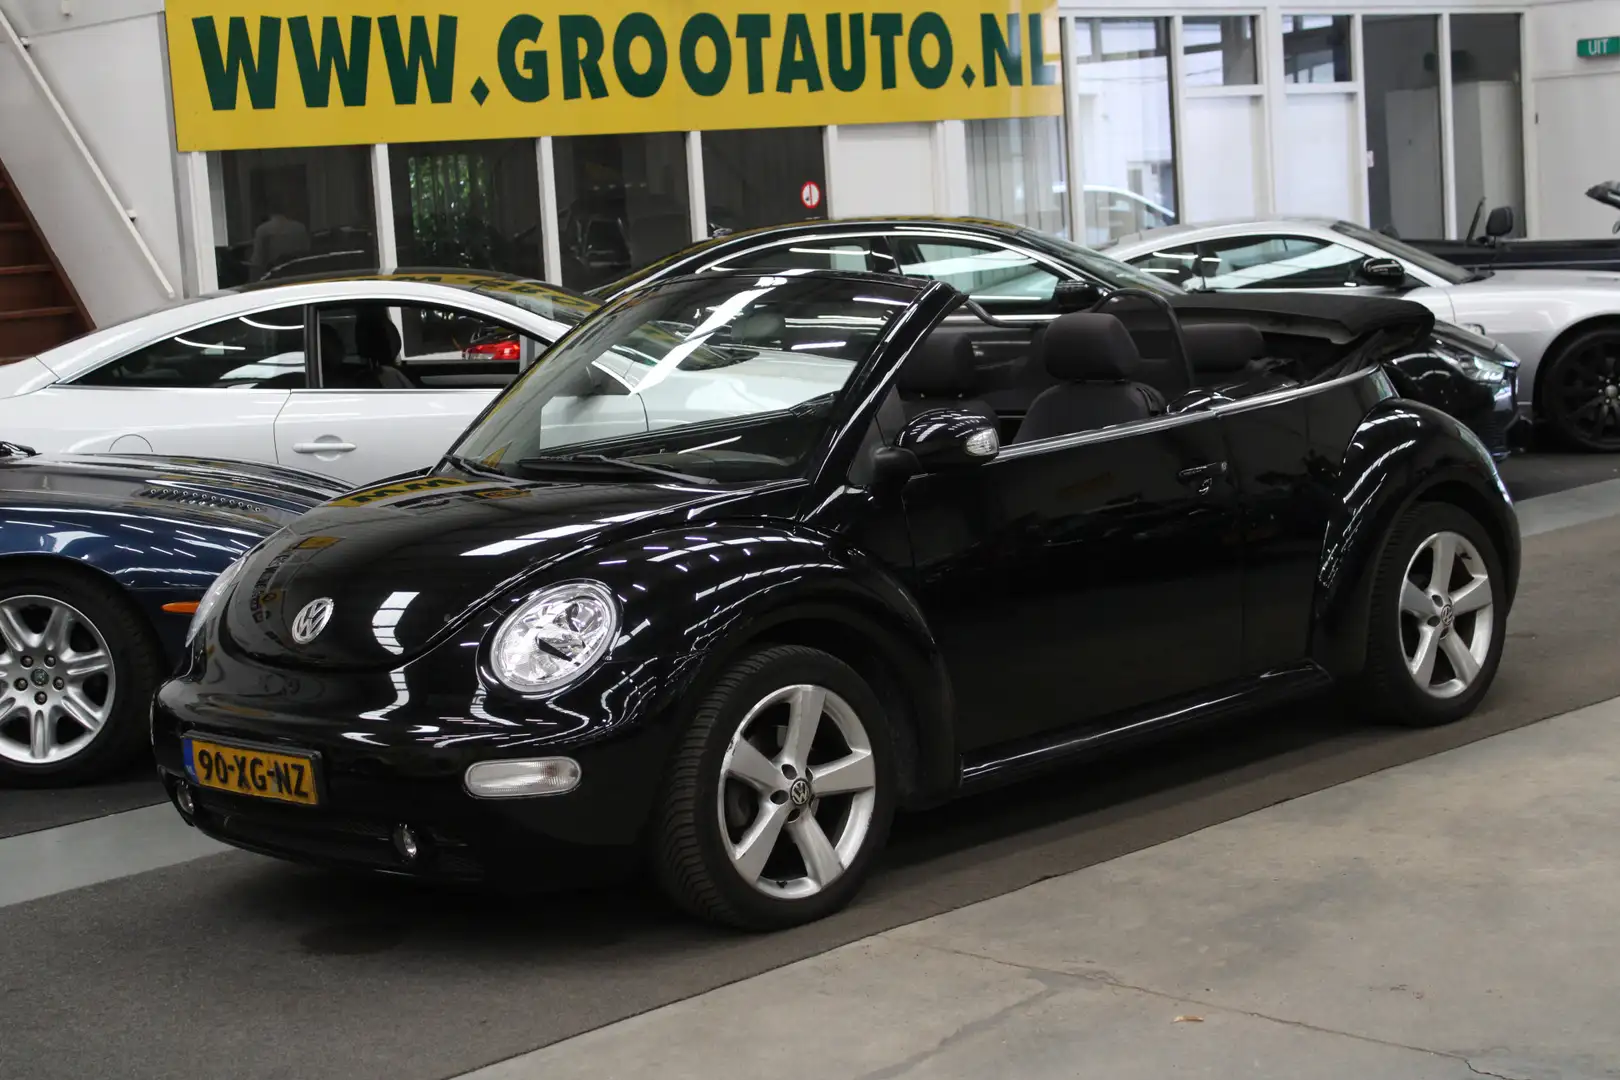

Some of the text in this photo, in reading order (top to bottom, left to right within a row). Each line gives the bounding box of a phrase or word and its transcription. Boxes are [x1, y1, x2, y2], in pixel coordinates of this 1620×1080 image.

[192, 12, 1057, 110] WWW.GROOTAUTO.NL
[1588, 39, 1608, 55] UIT
[198, 749, 309, 798] 90-XG-NZ
